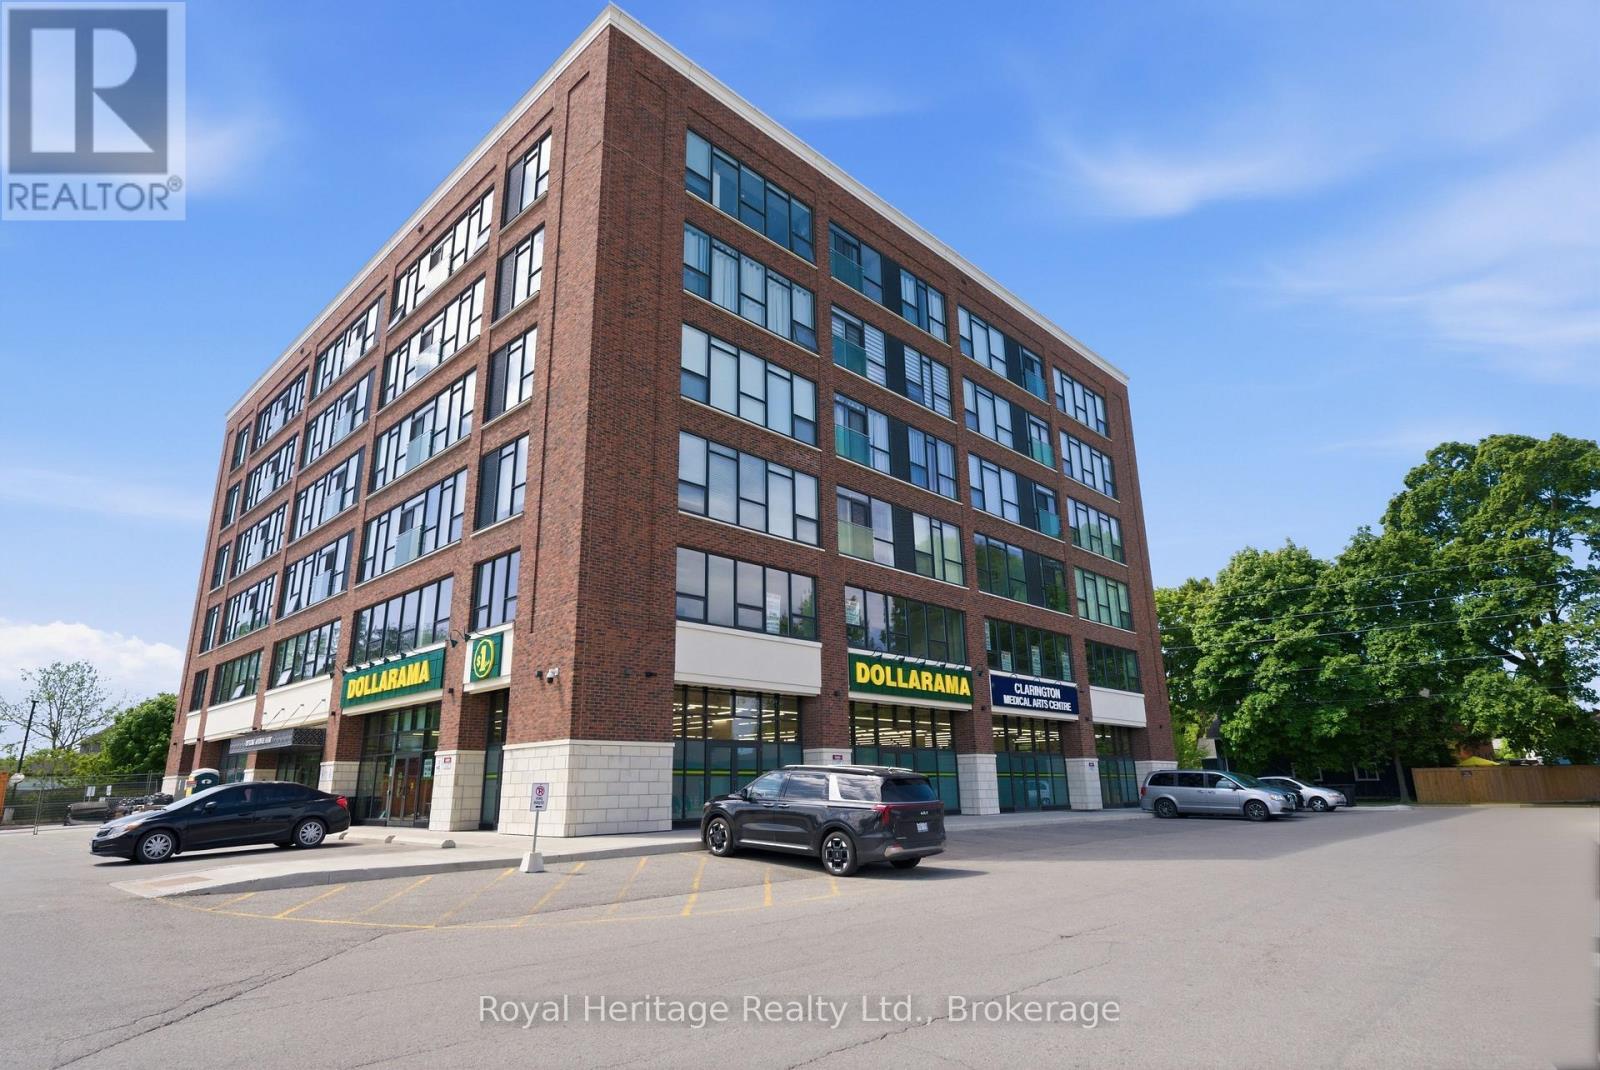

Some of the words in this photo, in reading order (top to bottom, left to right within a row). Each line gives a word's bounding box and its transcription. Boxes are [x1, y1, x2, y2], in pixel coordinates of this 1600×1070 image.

[346, 659, 430, 700] DOLLARAMA
[855, 662, 971, 697] DOLLARAMA
[1014, 683, 1061, 699] CLARINGTON
[1003, 695, 1032, 707] MEDICAL
[1032, 698, 1048, 708] ARTS
[1049, 700, 1072, 712] CENTRE
